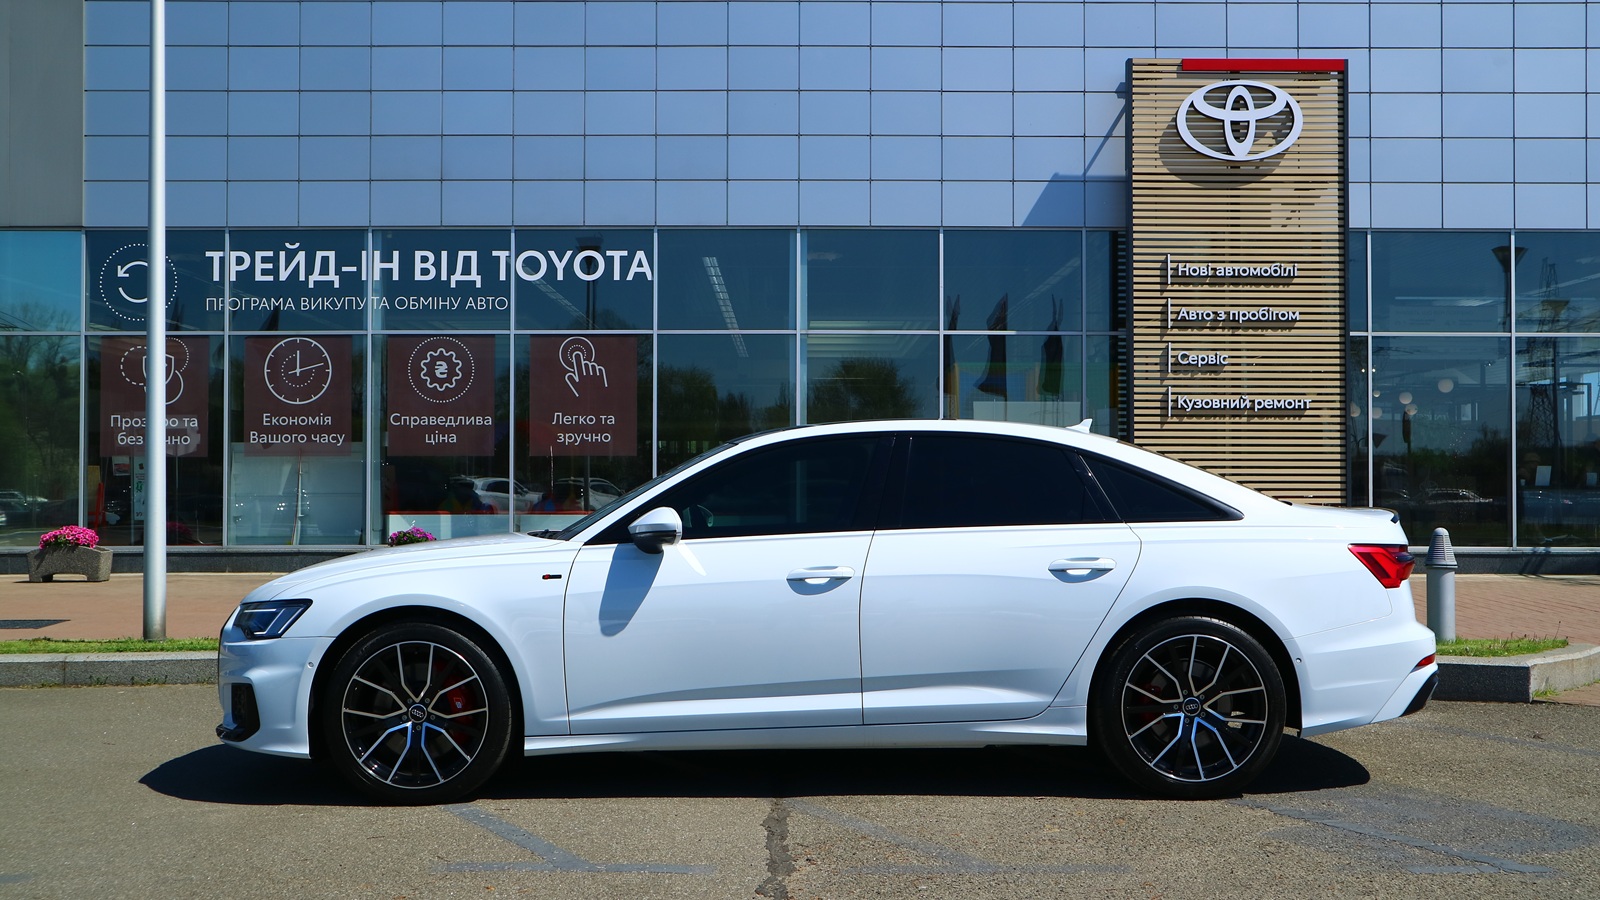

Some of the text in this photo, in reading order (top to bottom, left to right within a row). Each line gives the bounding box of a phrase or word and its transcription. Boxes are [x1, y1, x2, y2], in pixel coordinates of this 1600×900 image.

[205, 242, 653, 288] ТРЕЙД-ІН ВІД TOYOTA
[1178, 262, 1298, 277] Нові автомобілі
[205, 296, 509, 311] ПРОГРАМА ВИКУПУ ТА ОБМІНУ АВТО
[1177, 307, 1300, 323] Авто з пробігом
[1177, 351, 1229, 367] Сервіс
[1177, 396, 1312, 412] Кузовний ремонт
[182, 417, 198, 428] та
[262, 413, 332, 426] Економія
[389, 413, 493, 427] Справедлива
[552, 413, 616, 425] Легко та
[117, 432, 191, 445] безчно
[250, 431, 345, 446] Вашого часу
[425, 431, 457, 444] ціна
[556, 432, 612, 446] зручно
